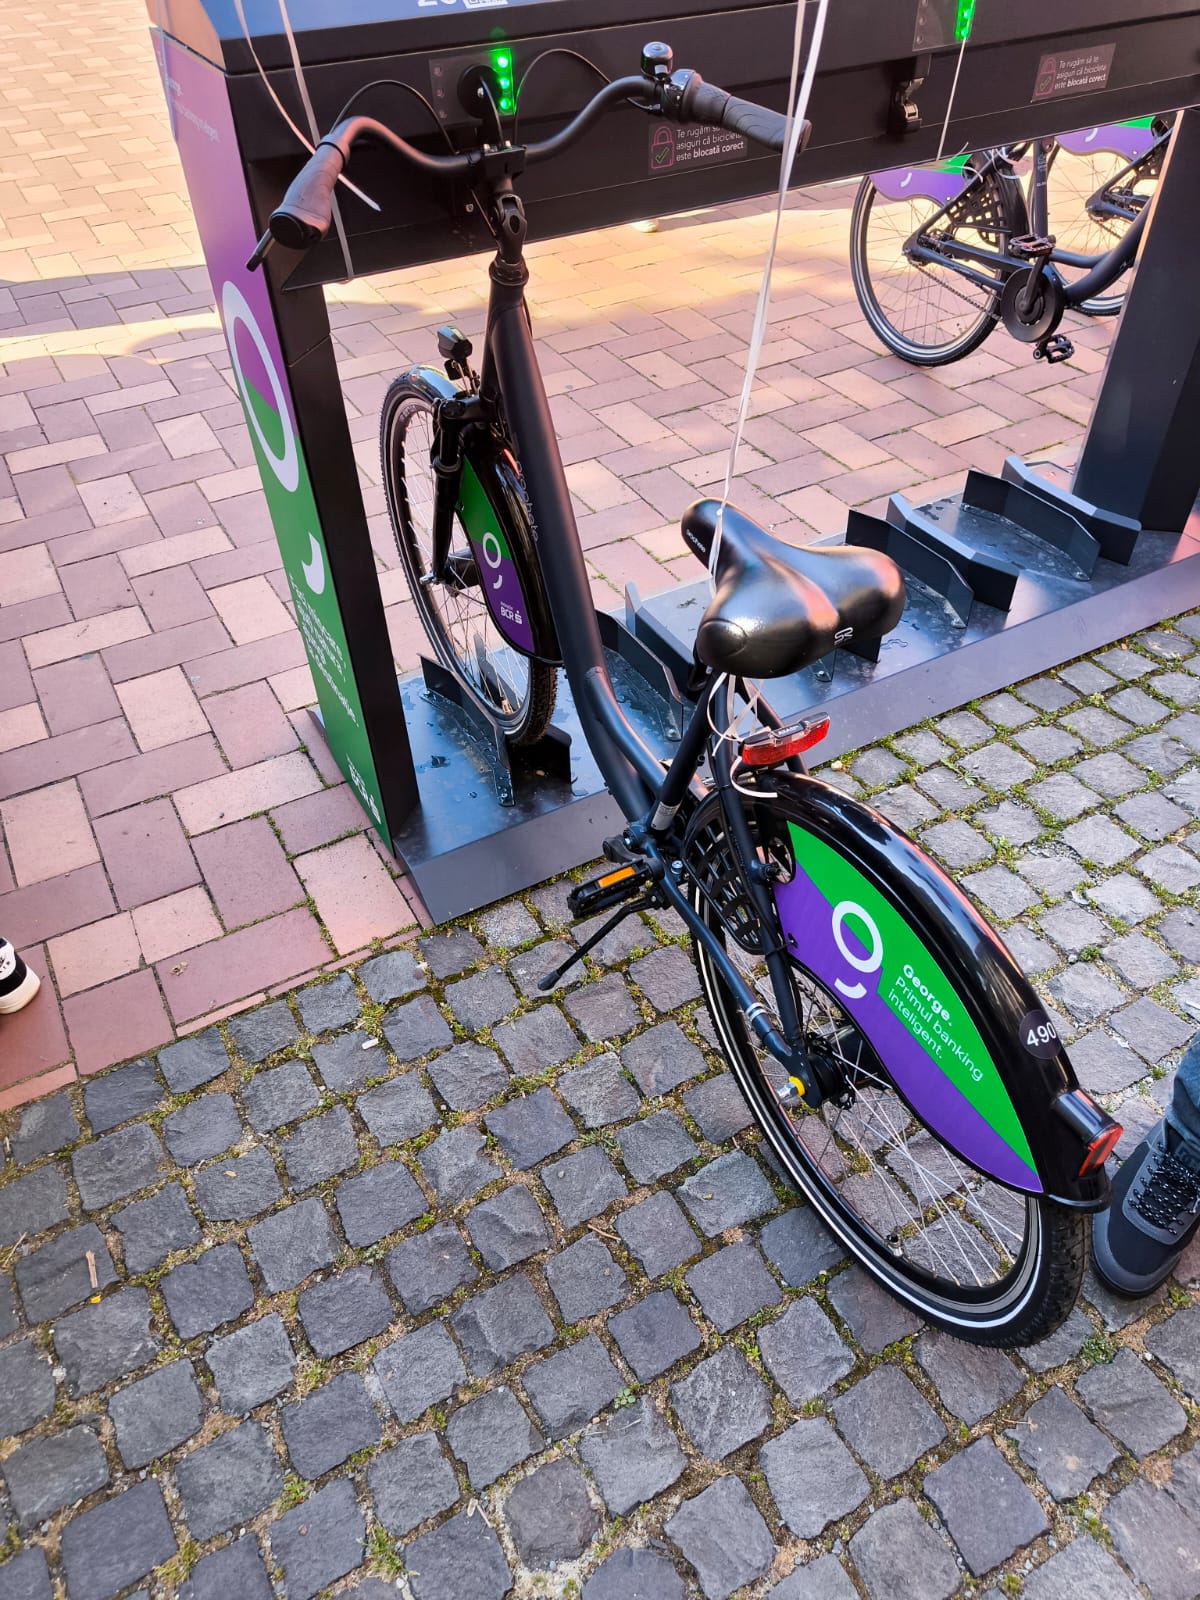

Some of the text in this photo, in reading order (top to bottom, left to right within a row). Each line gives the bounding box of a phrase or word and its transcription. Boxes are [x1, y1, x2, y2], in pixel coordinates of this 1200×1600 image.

[676, 129, 685, 139] Te
[687, 126, 711, 137] rugăm
[676, 138, 701, 150] asiguri
[676, 141, 744, 161] este blocată corect
[500, 606, 515, 621] BCR
[903, 964, 953, 1027] George.
[888, 988, 943, 1059] inteligent.
[895, 976, 984, 1083] Primul banking
[1027, 1021, 1057, 1048] 490
